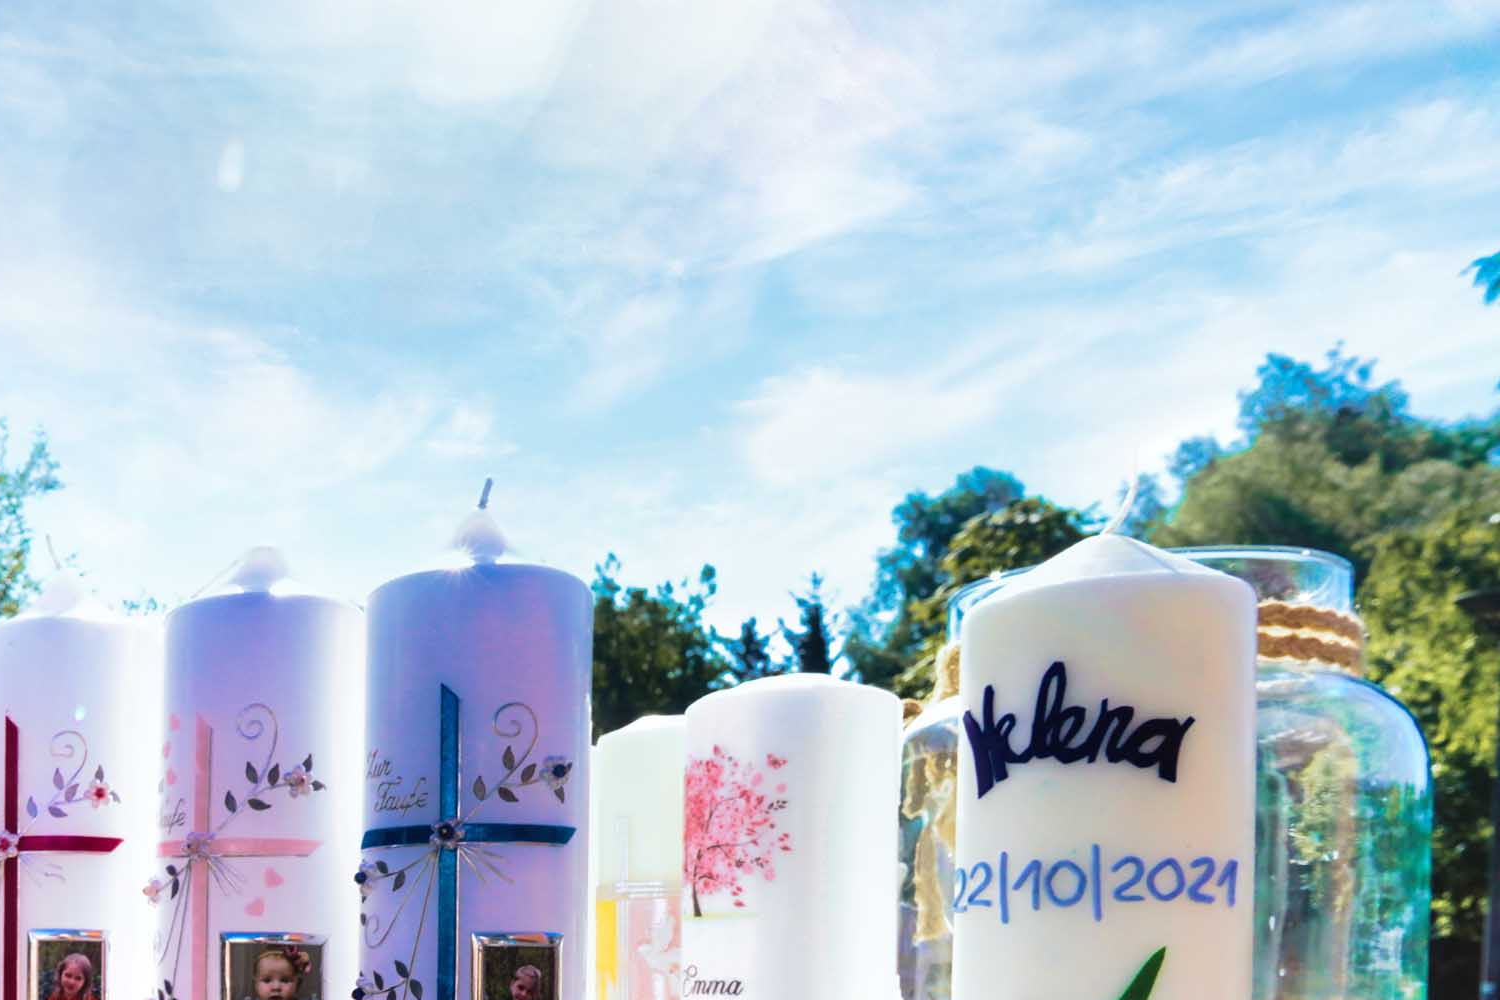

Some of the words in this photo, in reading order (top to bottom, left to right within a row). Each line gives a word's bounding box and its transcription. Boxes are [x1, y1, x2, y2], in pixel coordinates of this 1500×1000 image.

[963, 661, 1196, 799] Helena
[373, 776, 428, 817] Taufe
[683, 964, 744, 998] Emma
